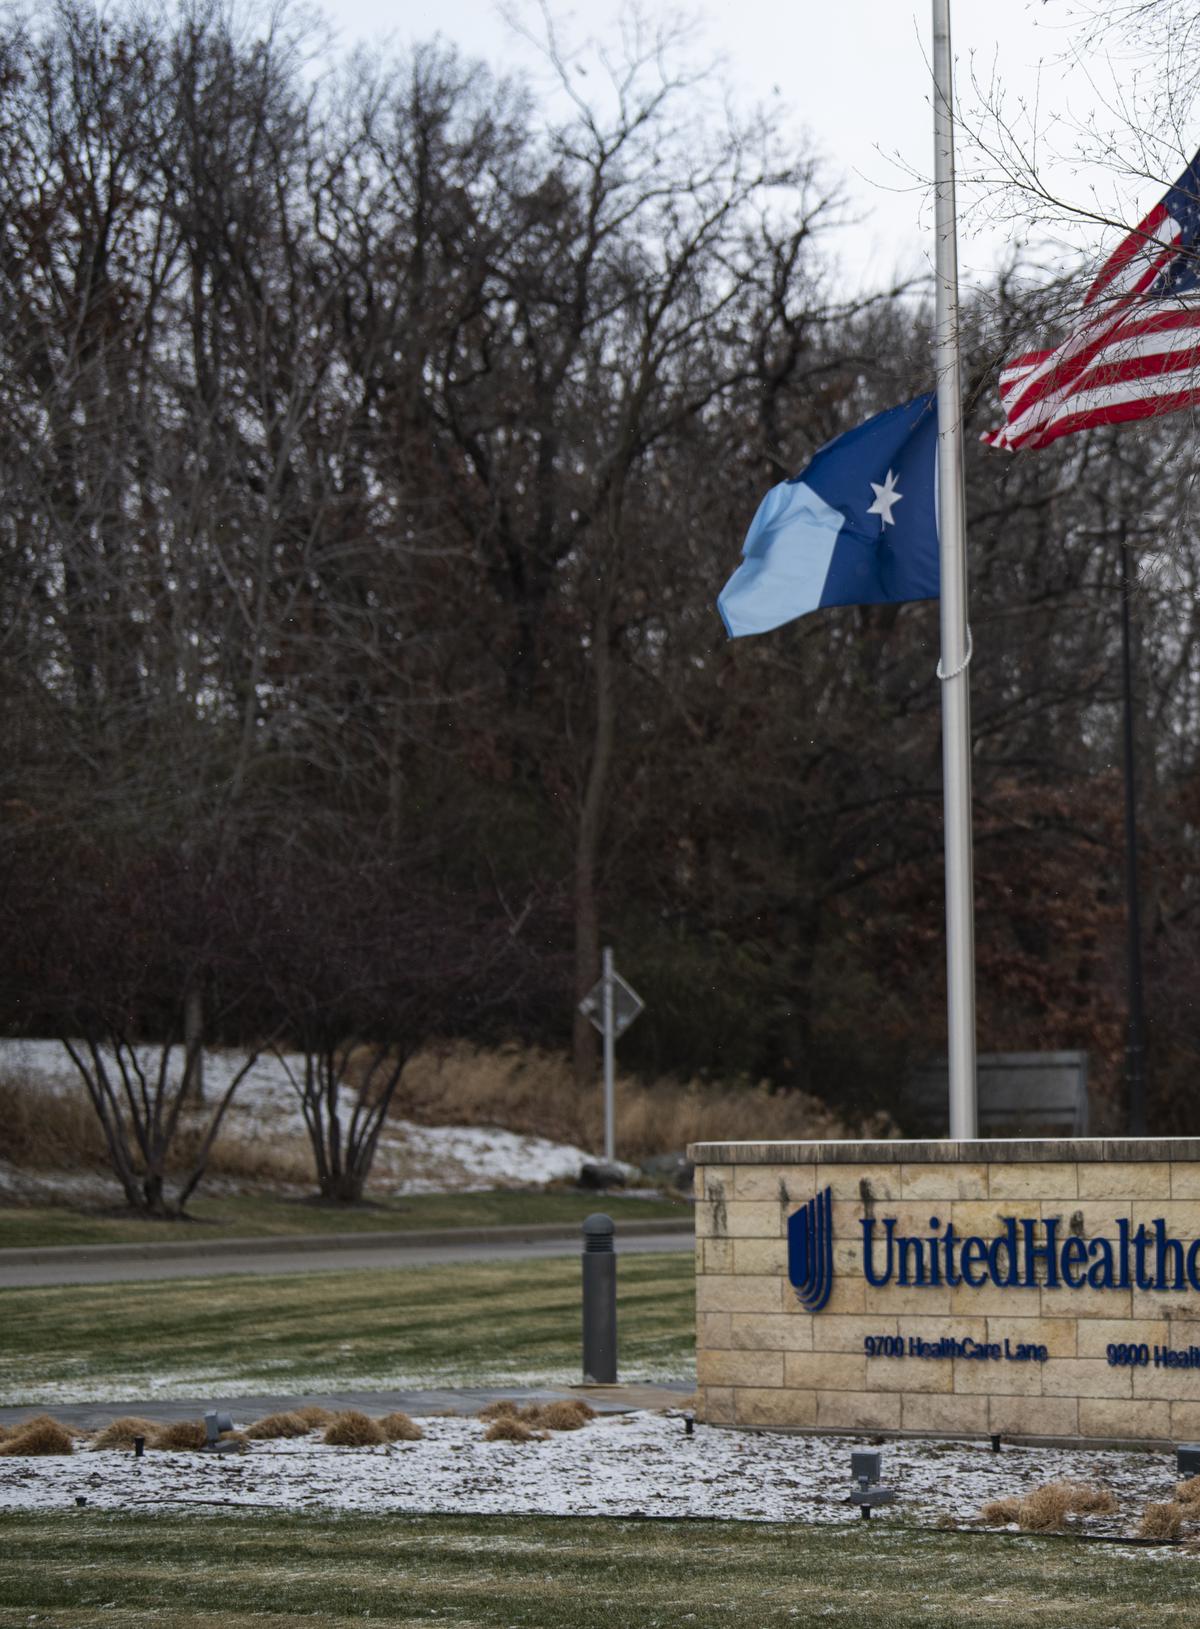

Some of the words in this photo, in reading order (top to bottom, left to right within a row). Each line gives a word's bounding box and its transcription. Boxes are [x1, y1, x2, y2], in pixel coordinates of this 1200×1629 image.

[864, 1336, 904, 1358] 9700
[908, 1337, 1000, 1361] HealthCare
[1004, 1338, 1048, 1363] Lane
[1106, 1343, 1149, 1367] 9800
